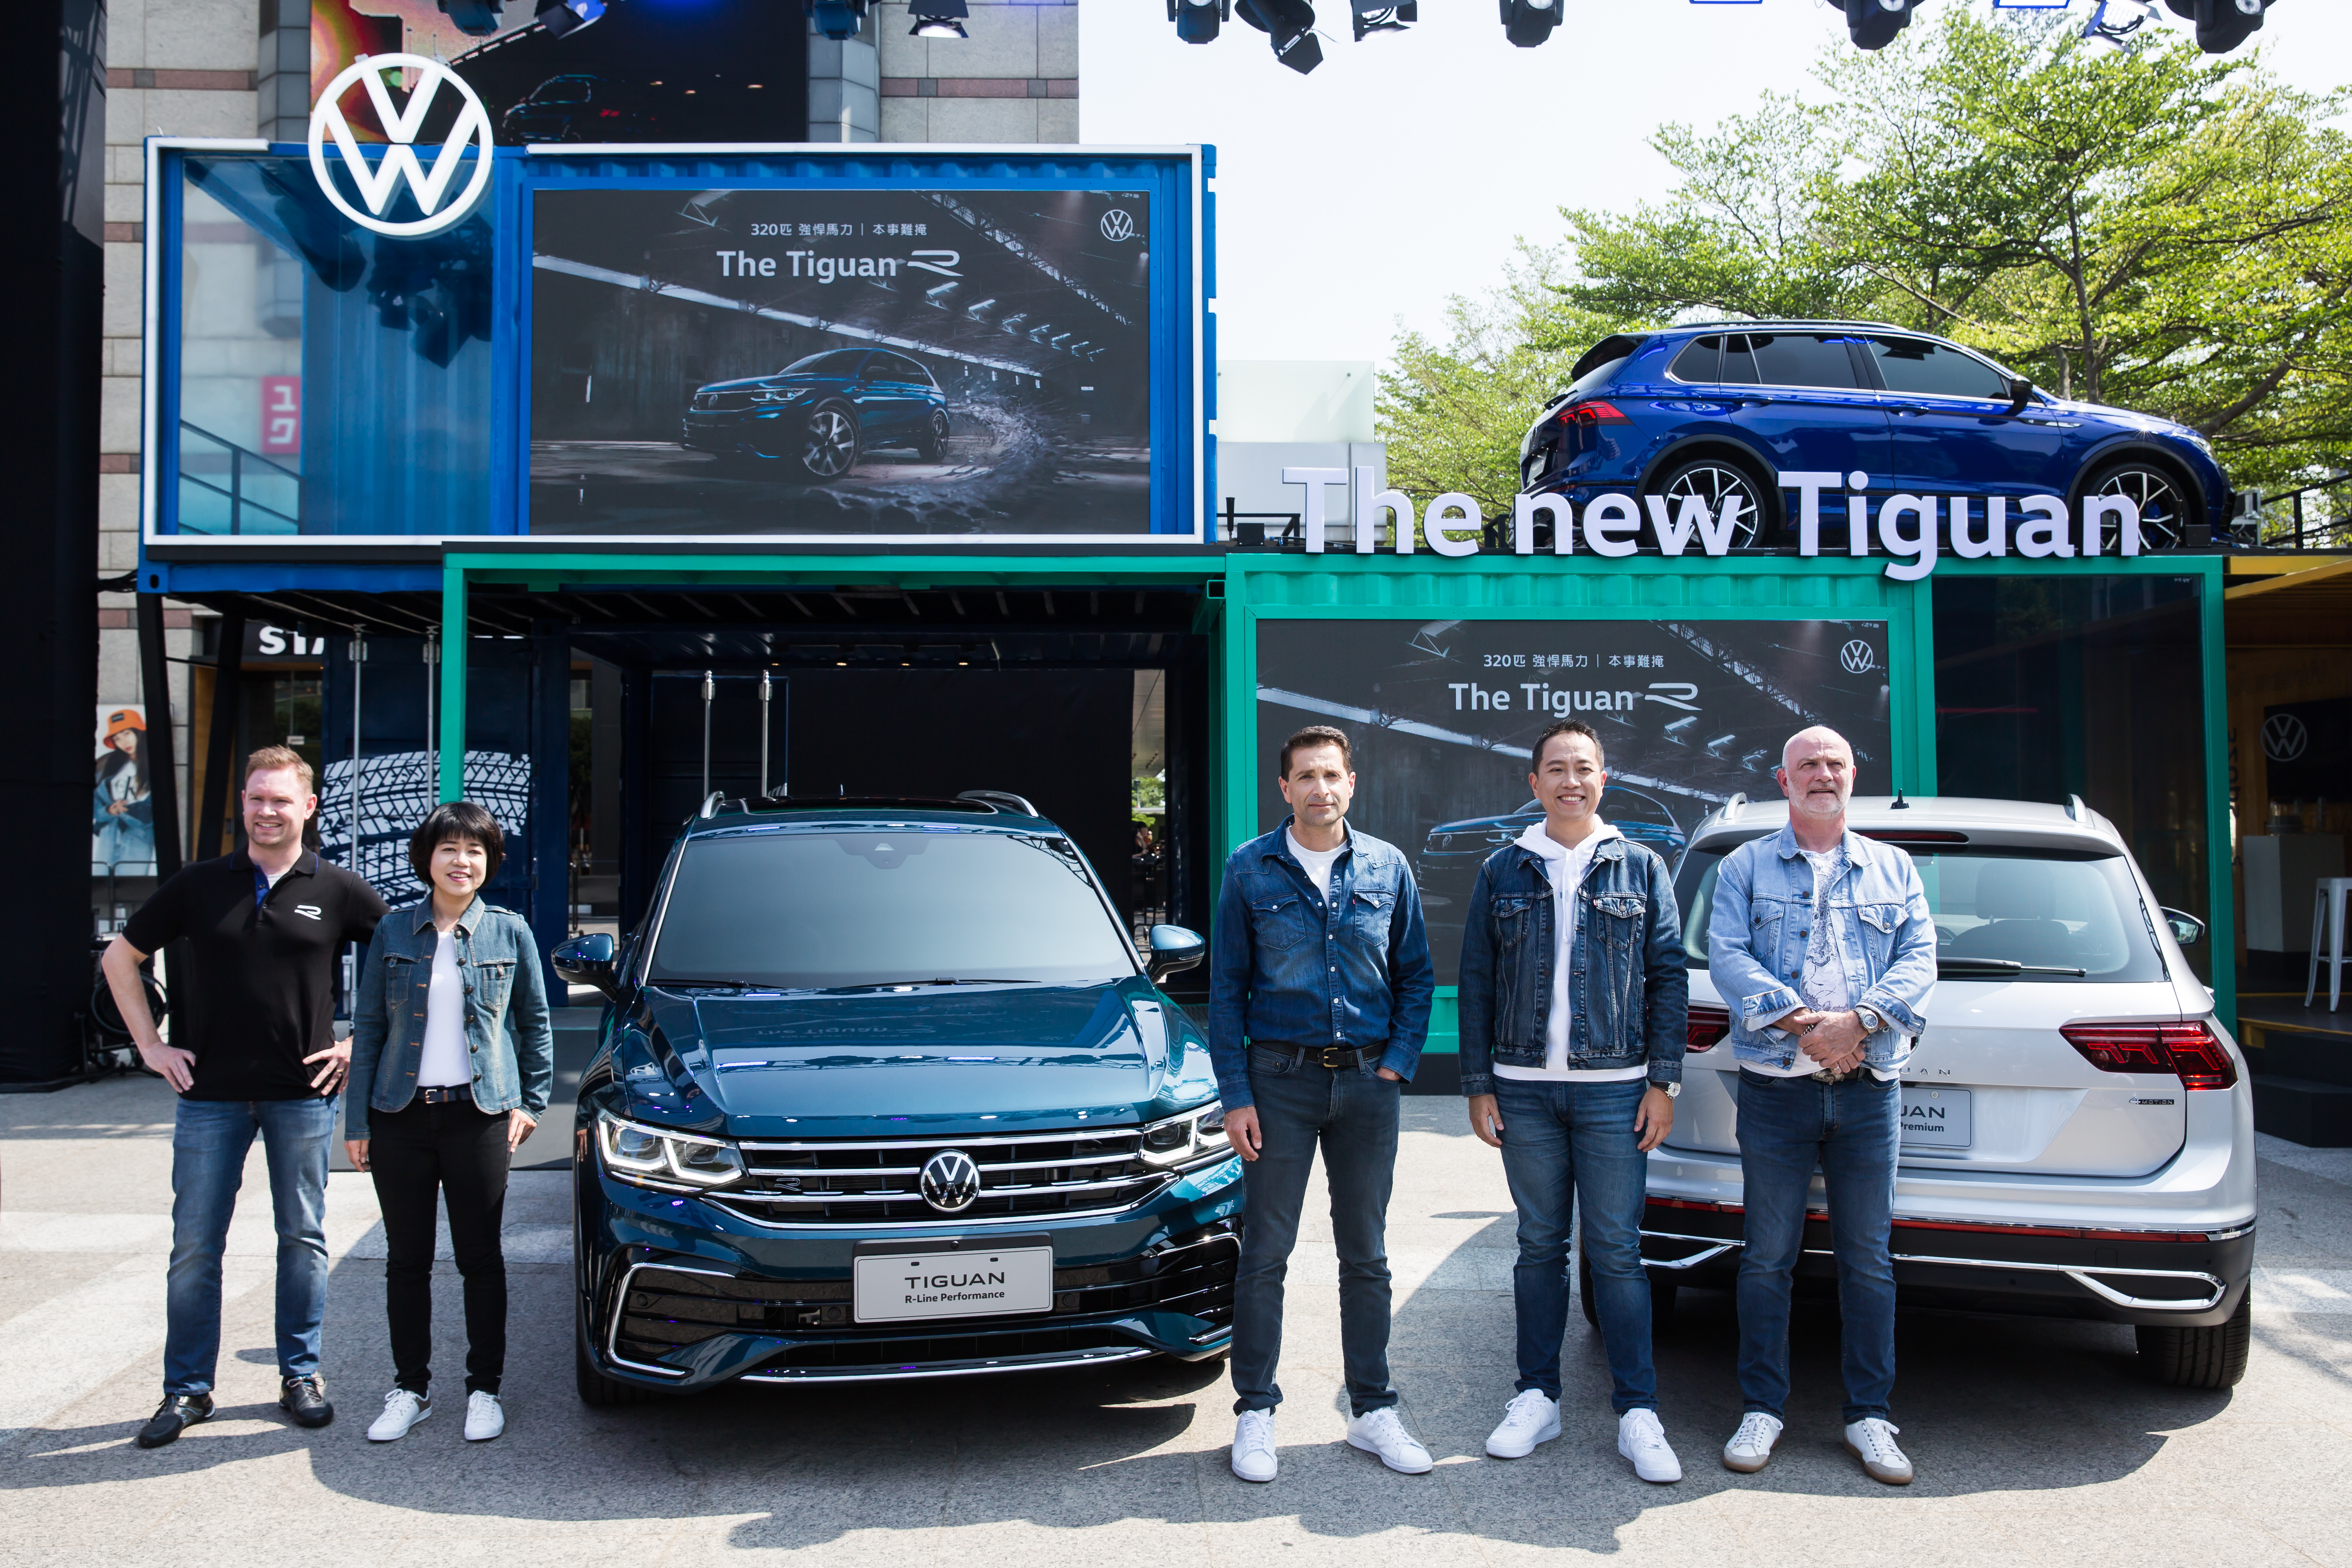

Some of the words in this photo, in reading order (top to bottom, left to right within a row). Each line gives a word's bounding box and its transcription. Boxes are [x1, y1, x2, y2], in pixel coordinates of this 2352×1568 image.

[751, 223, 792, 236] 320匹
[798, 223, 853, 236] 強悍馬力
[872, 223, 927, 236] 本事難掩
[716, 250, 776, 276] The
[786, 249, 897, 284] Tiguan
[1282, 466, 1482, 557] The
[1514, 492, 1743, 557] new
[1777, 470, 2139, 581] Tiguan
[1483, 654, 1526, 667] 320匹
[1532, 654, 1588, 667] 強悍馬力
[1608, 654, 1664, 667] 本事難掩
[1448, 683, 1510, 710] The
[1520, 682, 1633, 718] Tiguan
[2129, 1096, 2173, 1105] 4MOTION
[904, 1272, 1004, 1289] TIGUAN
[905, 1294, 938, 1303] R-Line
[940, 1291, 1005, 1302] Performance
